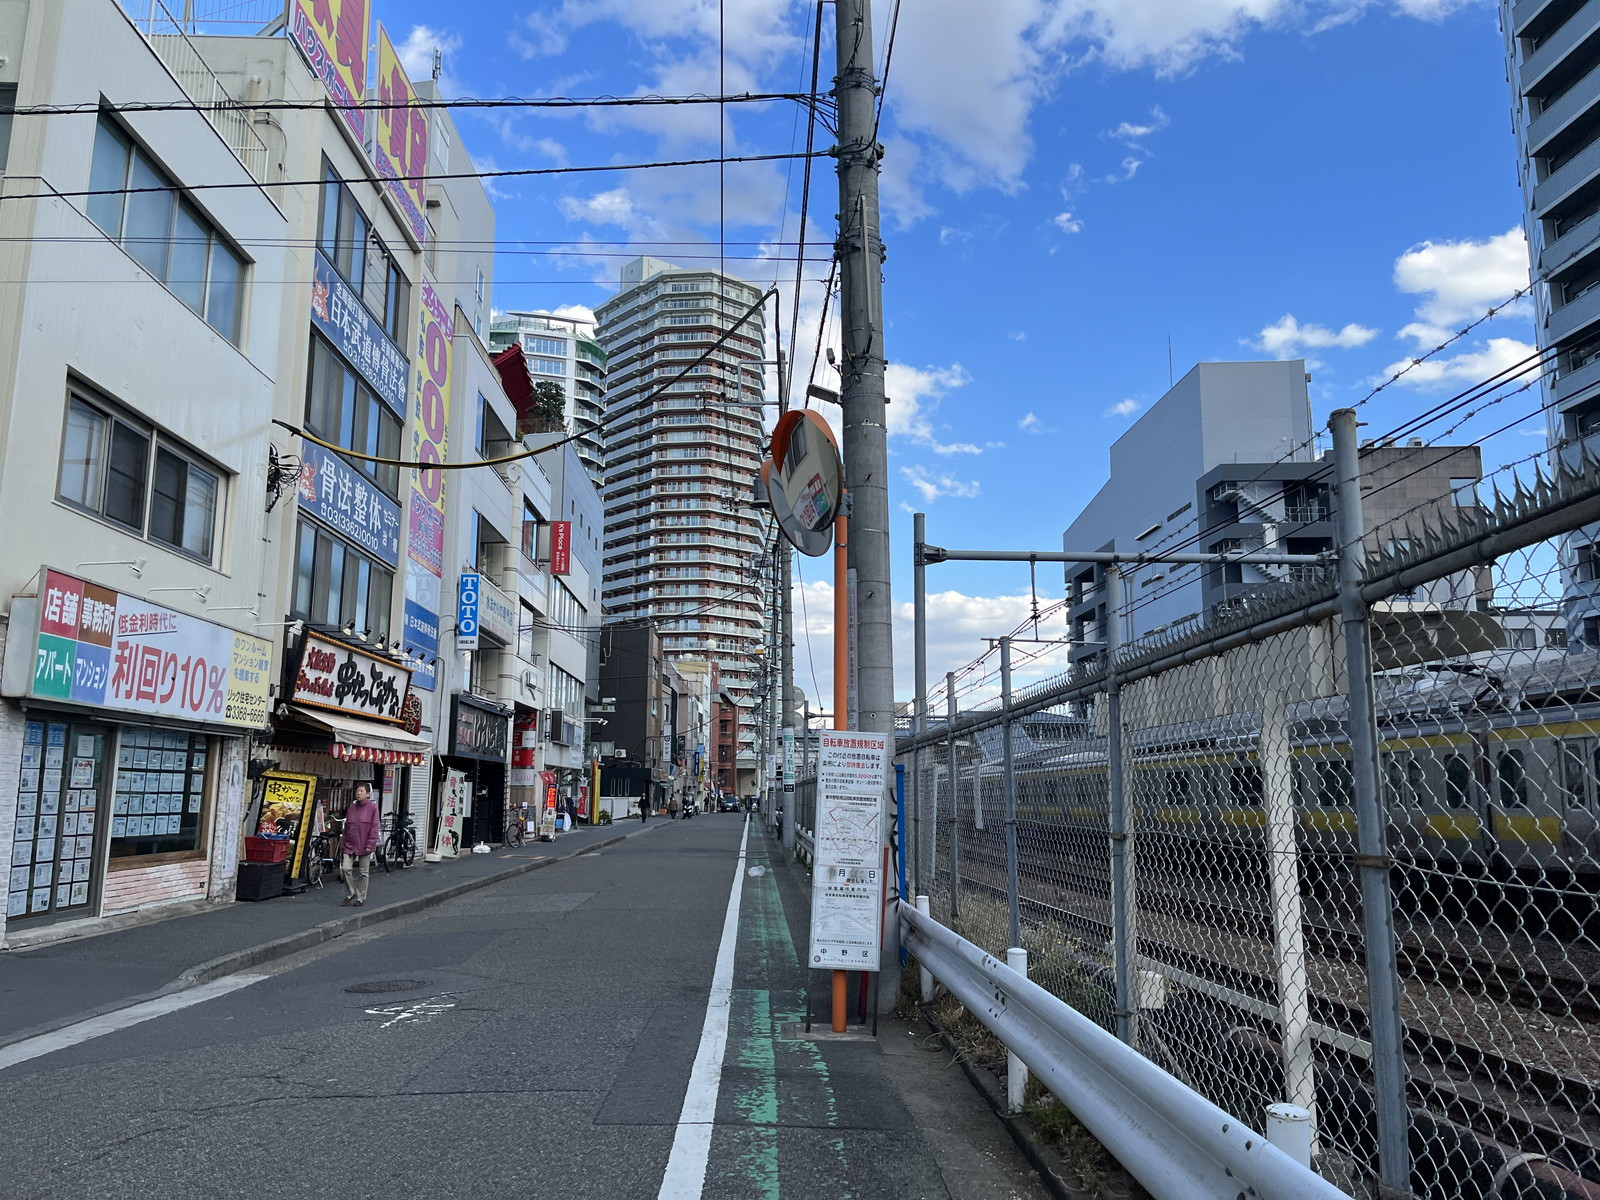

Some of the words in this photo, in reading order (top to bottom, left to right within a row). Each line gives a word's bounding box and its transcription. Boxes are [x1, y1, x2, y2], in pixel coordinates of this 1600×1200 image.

[320, 455, 382, 534] 骨法整体
[327, 506, 379, 551] 03(3362)0010
[45, 588, 79, 626] 店舗
[82, 597, 115, 636] 事務所
[118, 612, 177, 634] 低金利時代に
[460, 577, 477, 633] TOTO
[234, 637, 267, 657] のワンルーム
[36, 648, 72, 685] アパート
[76, 658, 107, 690] マンション
[111, 640, 227, 714] 利回り10%
[227, 688, 266, 707] リック住宅センター
[823, 738, 885, 750] 自転車放置規制区域
[827, 751, 880, 761] この付近の放置自転車は
[442, 776, 457, 847] 骨法整体
[820, 948, 869, 958] 中野区
